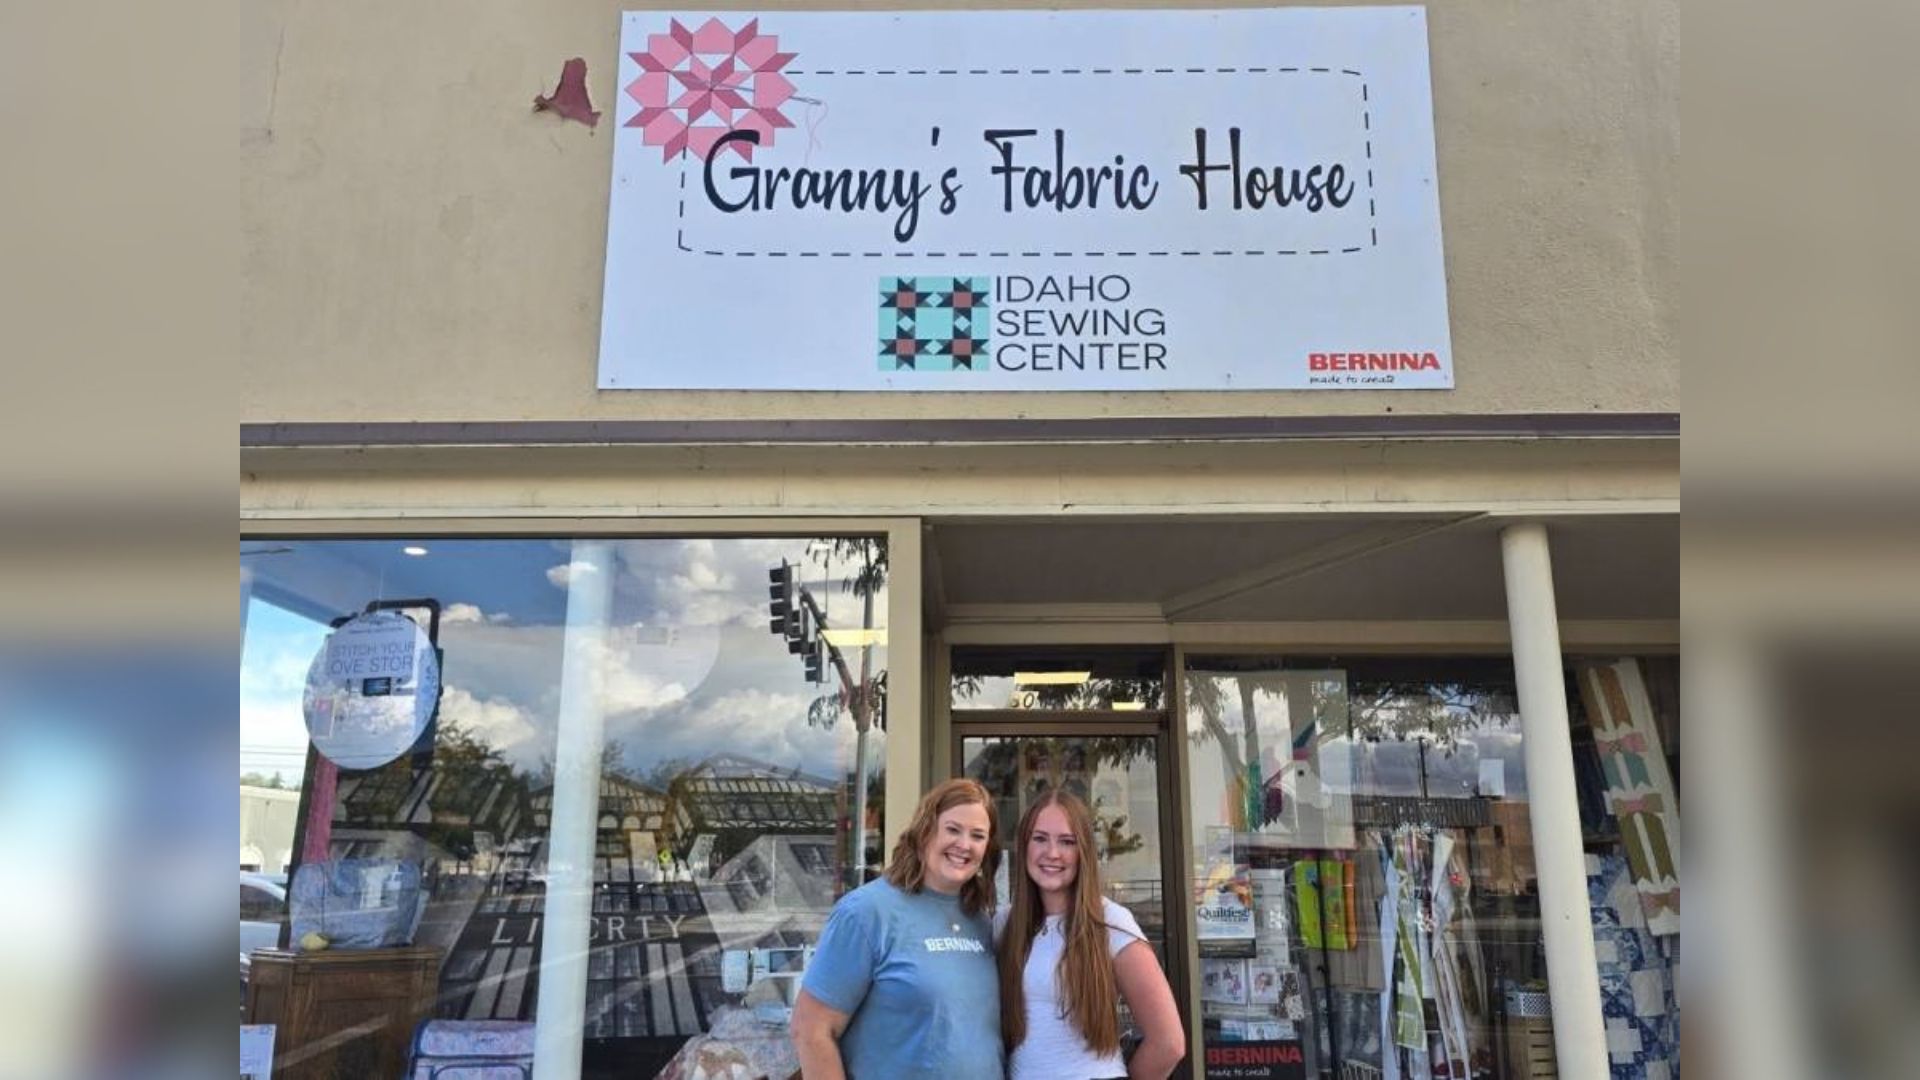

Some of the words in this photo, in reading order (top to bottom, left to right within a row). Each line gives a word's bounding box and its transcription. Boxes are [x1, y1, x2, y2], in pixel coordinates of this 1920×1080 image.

[703, 127, 963, 243] Granny's
[984, 129, 1159, 212] Fabric
[1179, 127, 1355, 212] House
[996, 274, 1131, 302] IDAHO
[996, 308, 1166, 337] SEWING
[996, 343, 1167, 371] CENTER
[1308, 353, 1441, 371] BERNINA
[1309, 375, 1342, 384] made
[1346, 375, 1358, 383] to
[1361, 375, 1395, 383] create
[330, 658, 363, 675] OVE
[369, 655, 413, 673] STOR
[491, 915, 686, 944] LIRTY
[924, 936, 985, 952] BERNINA
[1207, 1045, 1303, 1064] BERNINA
